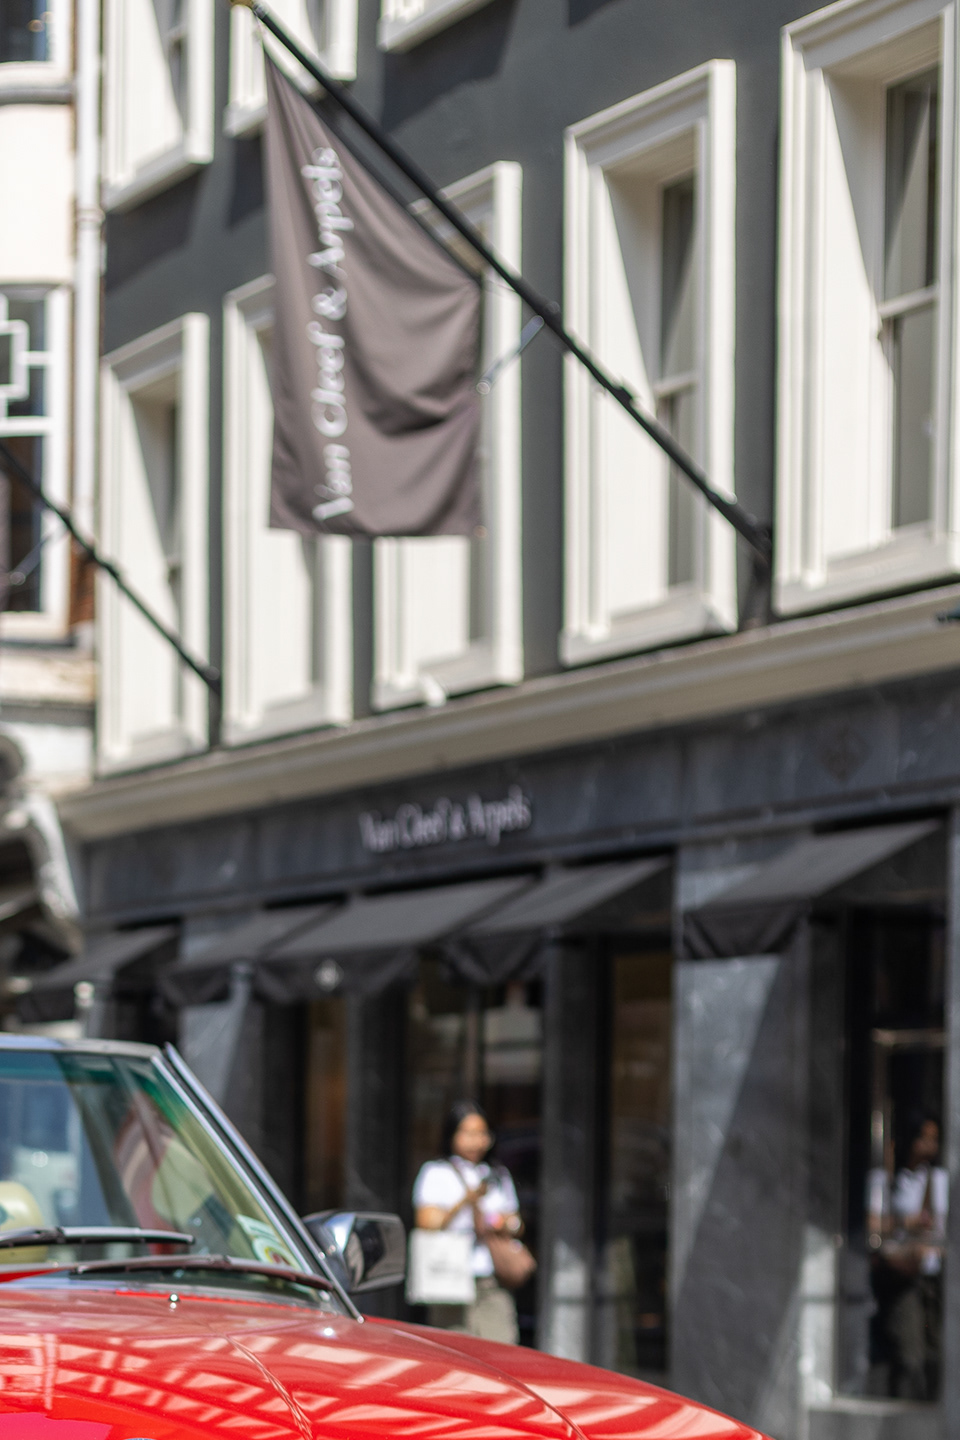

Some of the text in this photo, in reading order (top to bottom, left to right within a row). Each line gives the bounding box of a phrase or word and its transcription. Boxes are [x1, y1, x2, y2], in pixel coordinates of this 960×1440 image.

[301, 146, 355, 521] Van Cleef & Arpels
